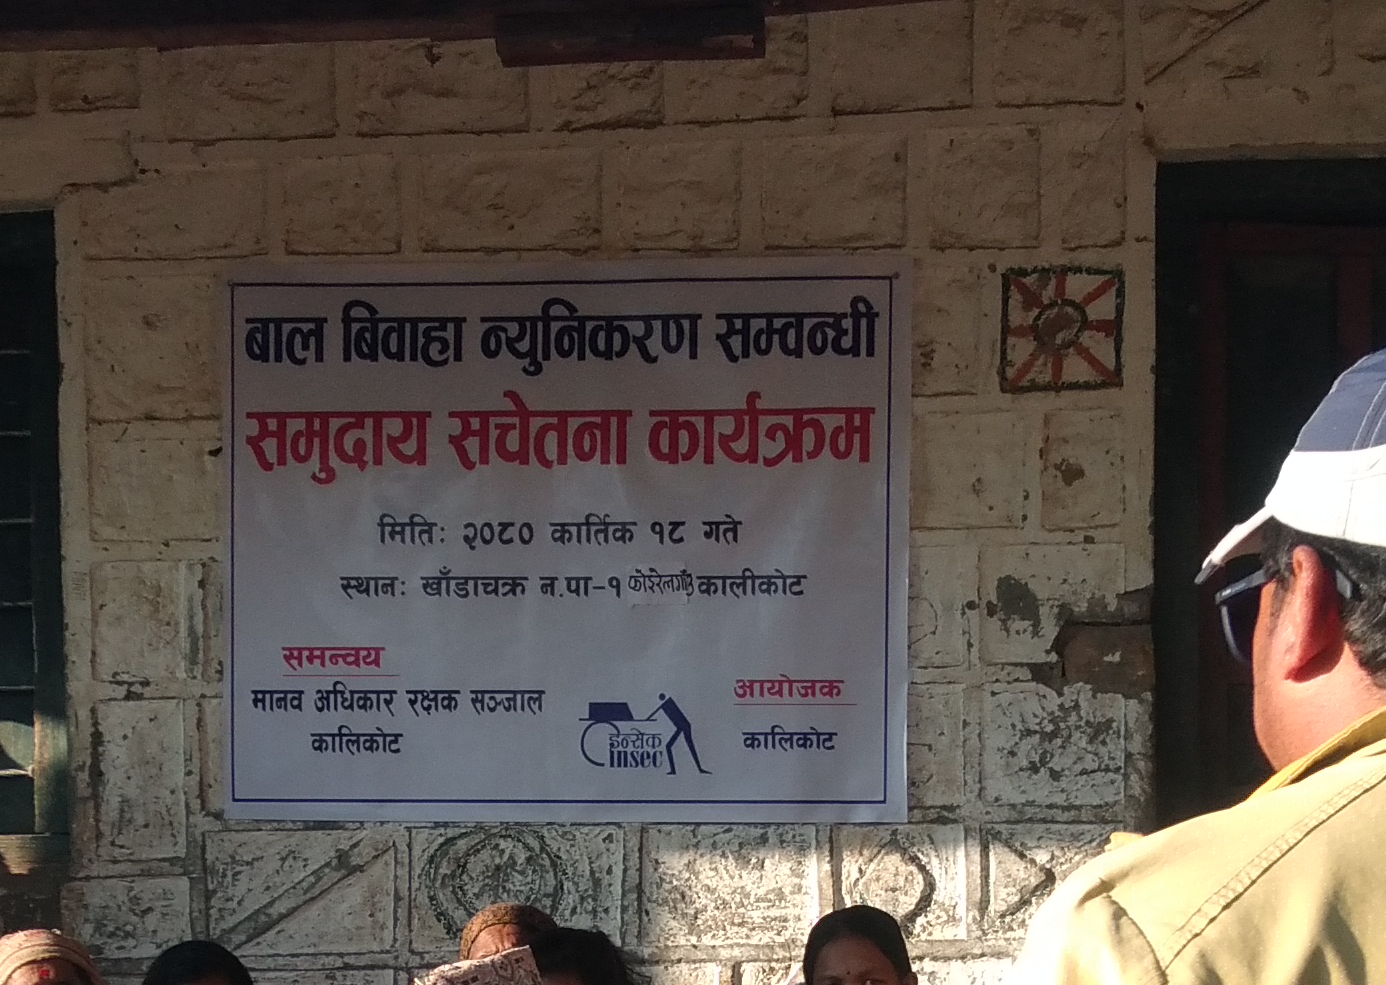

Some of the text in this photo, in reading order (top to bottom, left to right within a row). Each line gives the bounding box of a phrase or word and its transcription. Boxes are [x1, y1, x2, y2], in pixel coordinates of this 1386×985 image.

[245, 317, 328, 366] बाल
[341, 300, 467, 367] बिवाहा
[480, 297, 702, 376] न्युनिकरण
[246, 390, 875, 484] समुदाय सचेतना कार्यक्रम
[462, 521, 534, 550] २०८०
[549, 513, 638, 545] कार्तिक
[650, 520, 686, 546] १८
[702, 514, 744, 546] गते
[421, 566, 526, 599] खाँडाचक्र
[696, 568, 808, 599] कालीकोट
[282, 646, 386, 671] समन्वय
[251, 682, 546, 716] मानव अधिकार रक्षक सञ्जाल
[734, 674, 844, 699] आयोजक
[310, 727, 404, 755] कालिकोट
[742, 725, 838, 752] कालिकोट
[609, 749, 663, 768] insec
